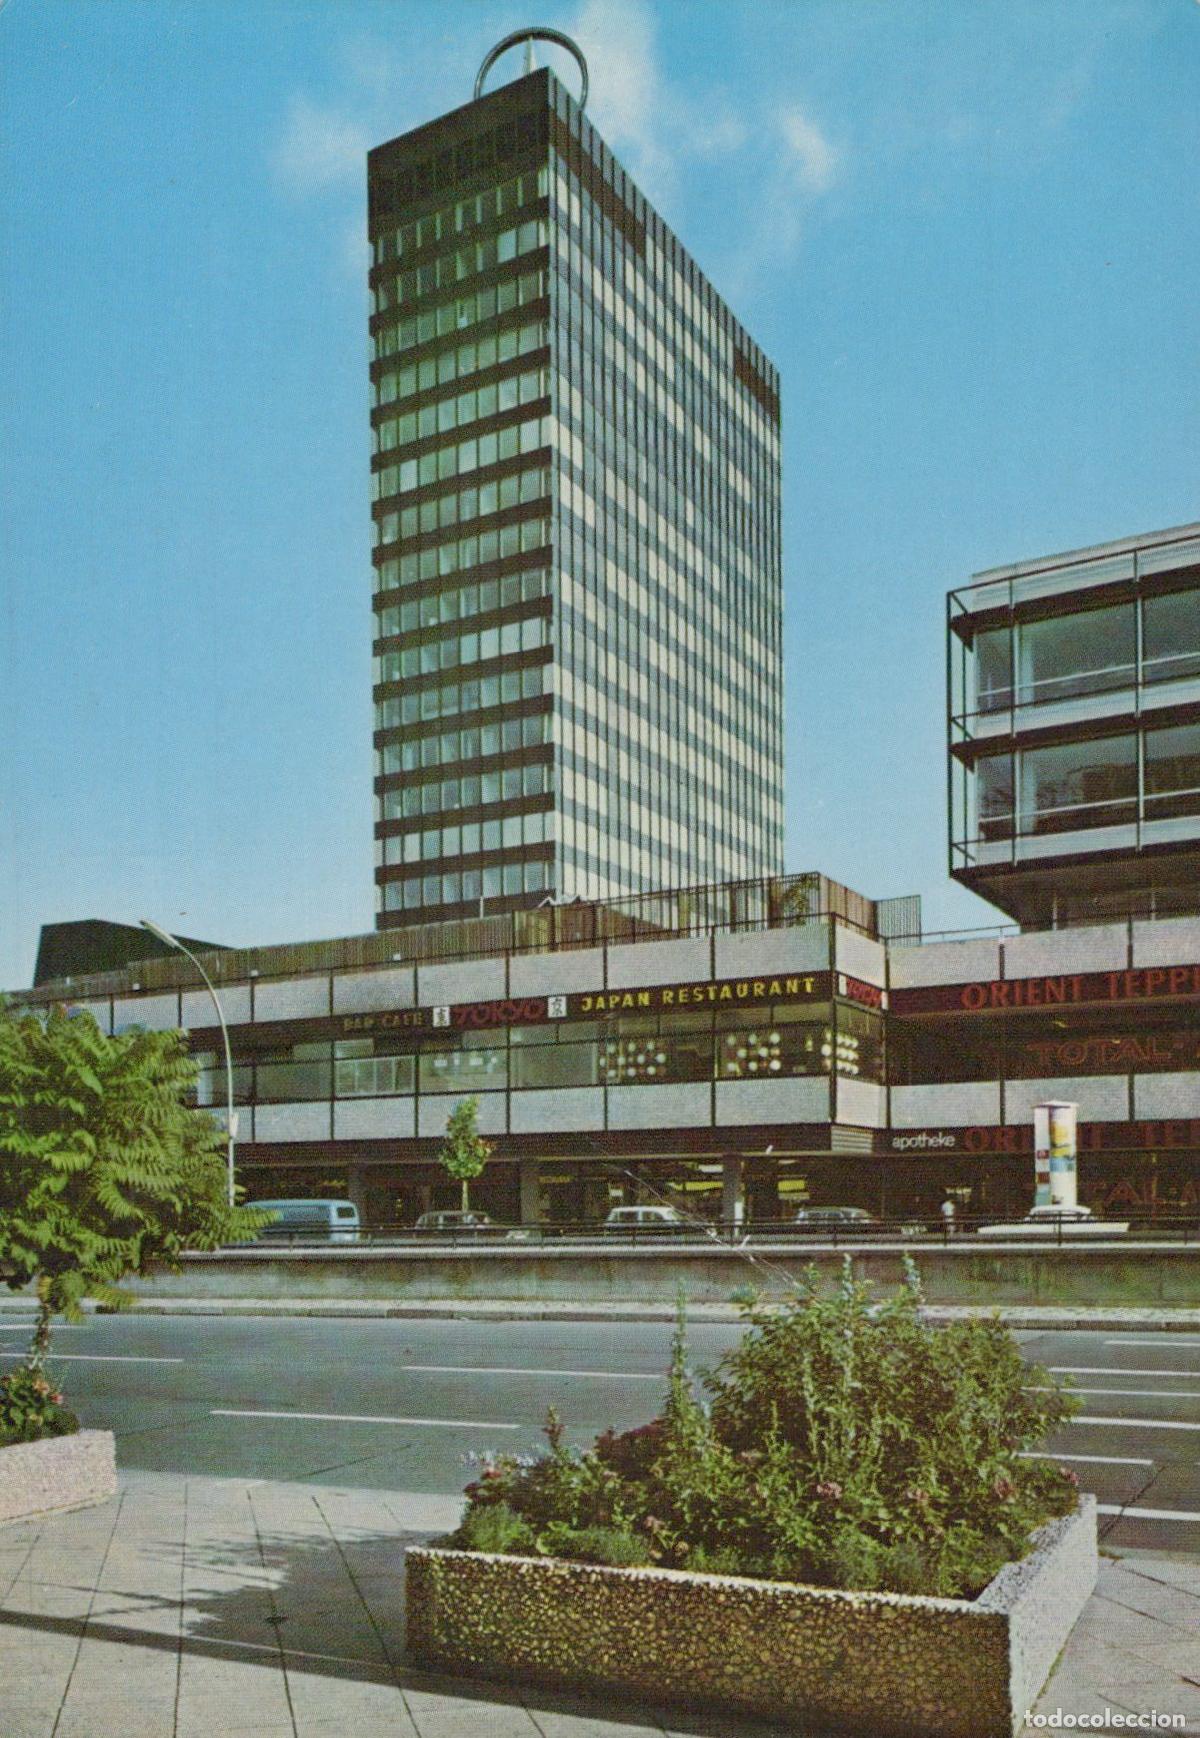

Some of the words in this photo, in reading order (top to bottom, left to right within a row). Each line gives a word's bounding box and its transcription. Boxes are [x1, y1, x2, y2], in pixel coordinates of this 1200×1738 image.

[582, 992, 650, 1011] JAPAN
[662, 977, 815, 1004] RESTAURANT
[961, 975, 1084, 1009] ORIENT
[453, 999, 546, 1024] TOKYO
[892, 1131, 956, 1151] apotheke
